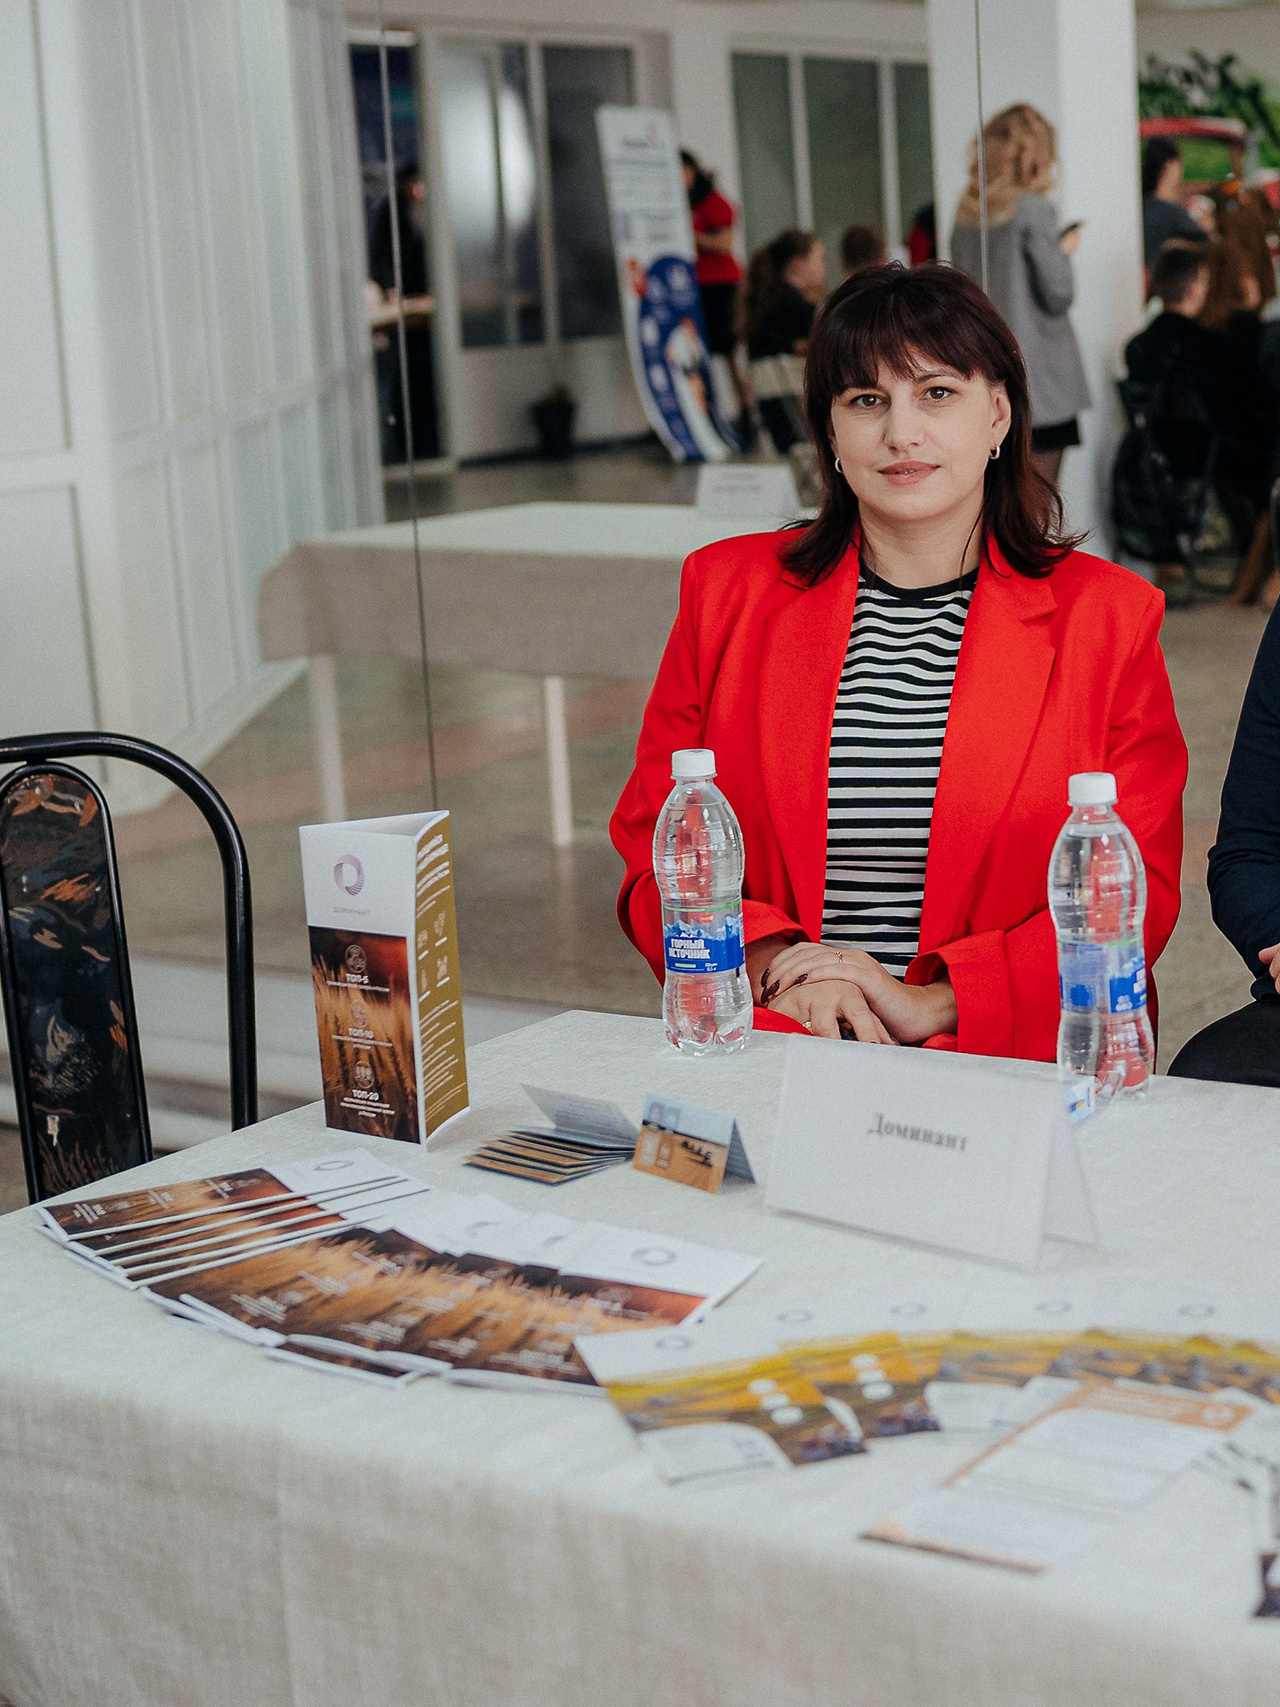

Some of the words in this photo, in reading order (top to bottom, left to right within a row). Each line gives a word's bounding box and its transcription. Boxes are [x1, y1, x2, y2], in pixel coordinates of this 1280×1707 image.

[672, 939, 704, 949] ГОРНЫЙ
[669, 947, 710, 959] ИСТОЧНИК
[346, 973, 370, 985] ТОП-5
[348, 1027, 375, 1039] ТОП-10
[352, 1089, 380, 1102] ТОП-20
[868, 1111, 968, 1151] Доминант
